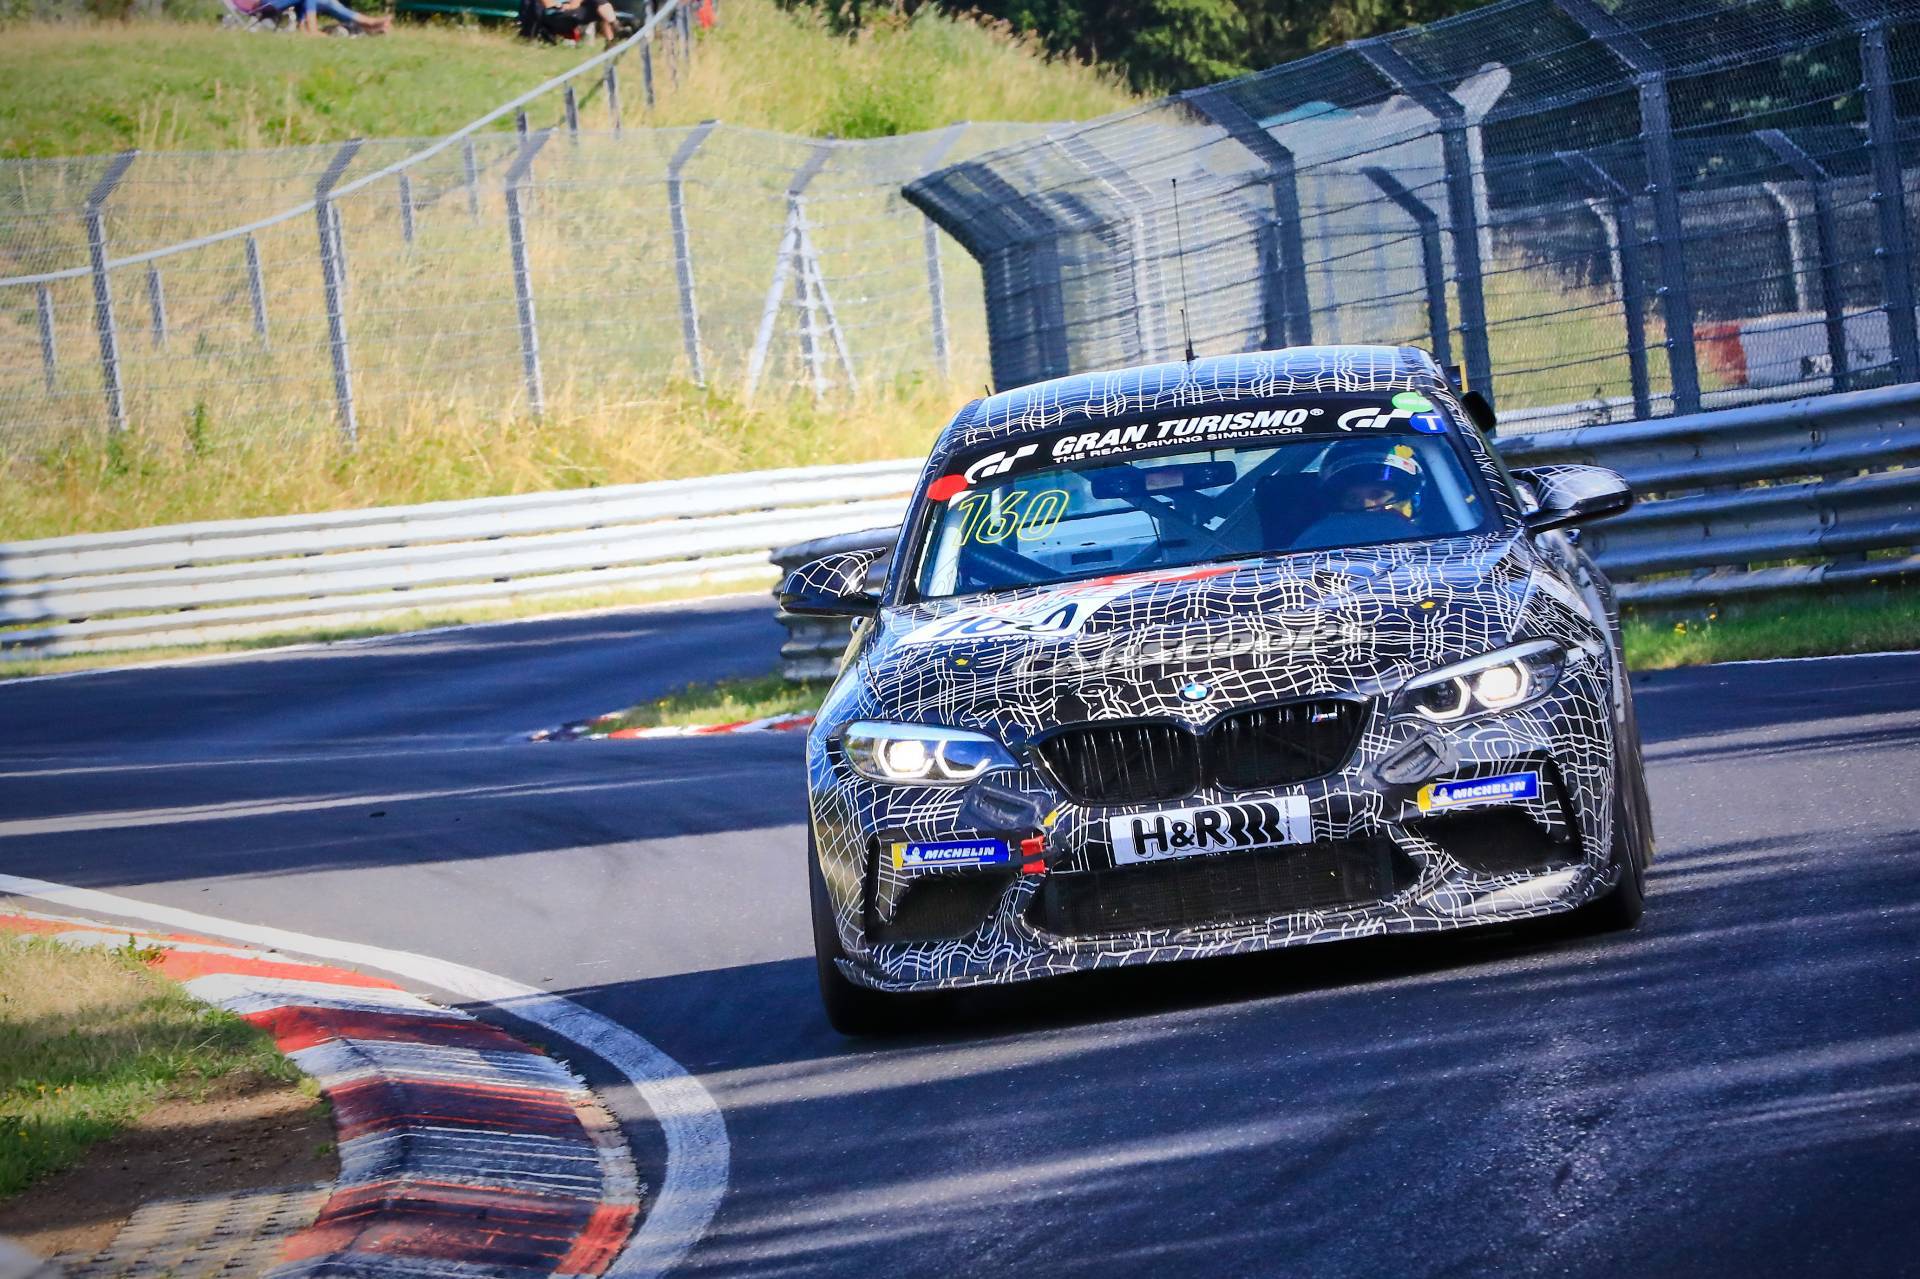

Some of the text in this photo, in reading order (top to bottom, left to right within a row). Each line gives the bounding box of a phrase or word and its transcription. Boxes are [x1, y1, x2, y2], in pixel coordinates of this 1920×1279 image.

[1051, 423, 1150, 457] GRAN
[1053, 425, 1304, 464] THE REAL DRIVING SIMULATOR
[953, 489, 1070, 547] 160
[1452, 781, 1527, 800] MICHELIN
[923, 846, 996, 860] MICHELIN
